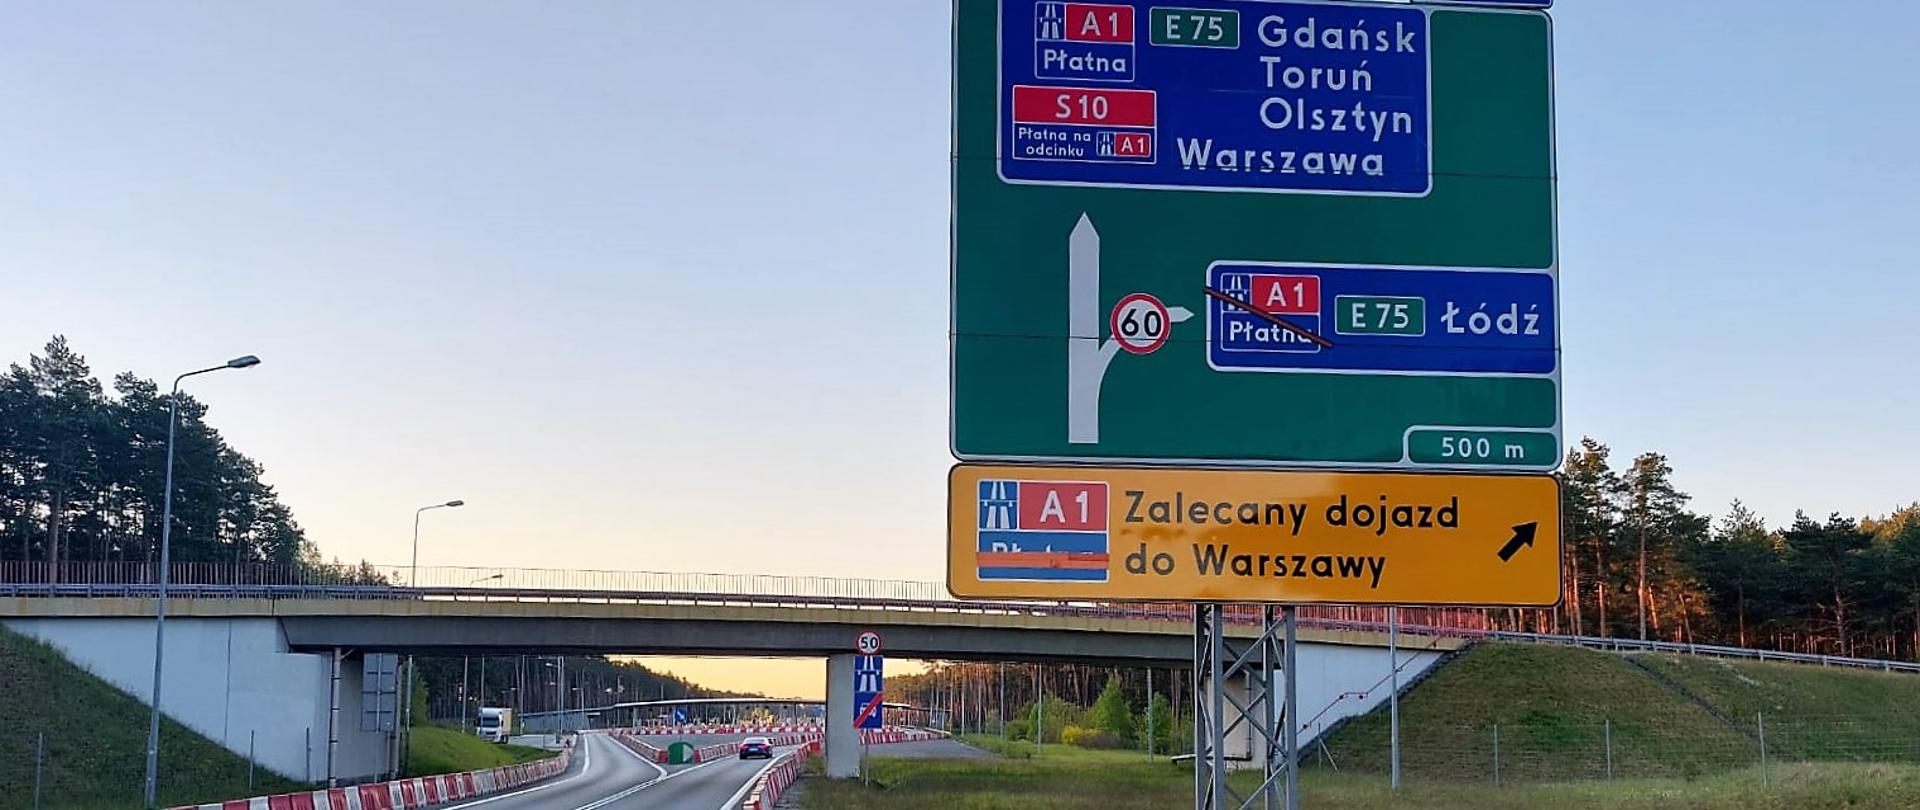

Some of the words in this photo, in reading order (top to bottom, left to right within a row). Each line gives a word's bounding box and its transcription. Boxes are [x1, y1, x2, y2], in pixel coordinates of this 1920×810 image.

[1257, 15, 1416, 53] Gdańsk
[1044, 49, 1126, 72] Płatna
[1260, 56, 1372, 92] Toruń
[1019, 127, 1067, 141] Płatna
[1074, 132, 1091, 142] na
[1260, 97, 1413, 141] Olsztyn
[1026, 143, 1084, 157] odcinku
[1177, 138, 1385, 176] Warszawa
[1121, 308, 1162, 338] 60
[1441, 301, 1539, 335] Łódź
[1441, 437, 1490, 459] 500
[1505, 442, 1524, 459] m
[1124, 491, 1305, 529] Zalecany
[1325, 494, 1459, 531] dojazd
[1125, 544, 1174, 576] do
[1192, 543, 1385, 587] Warszawy
[860, 636, 878, 649] 50
